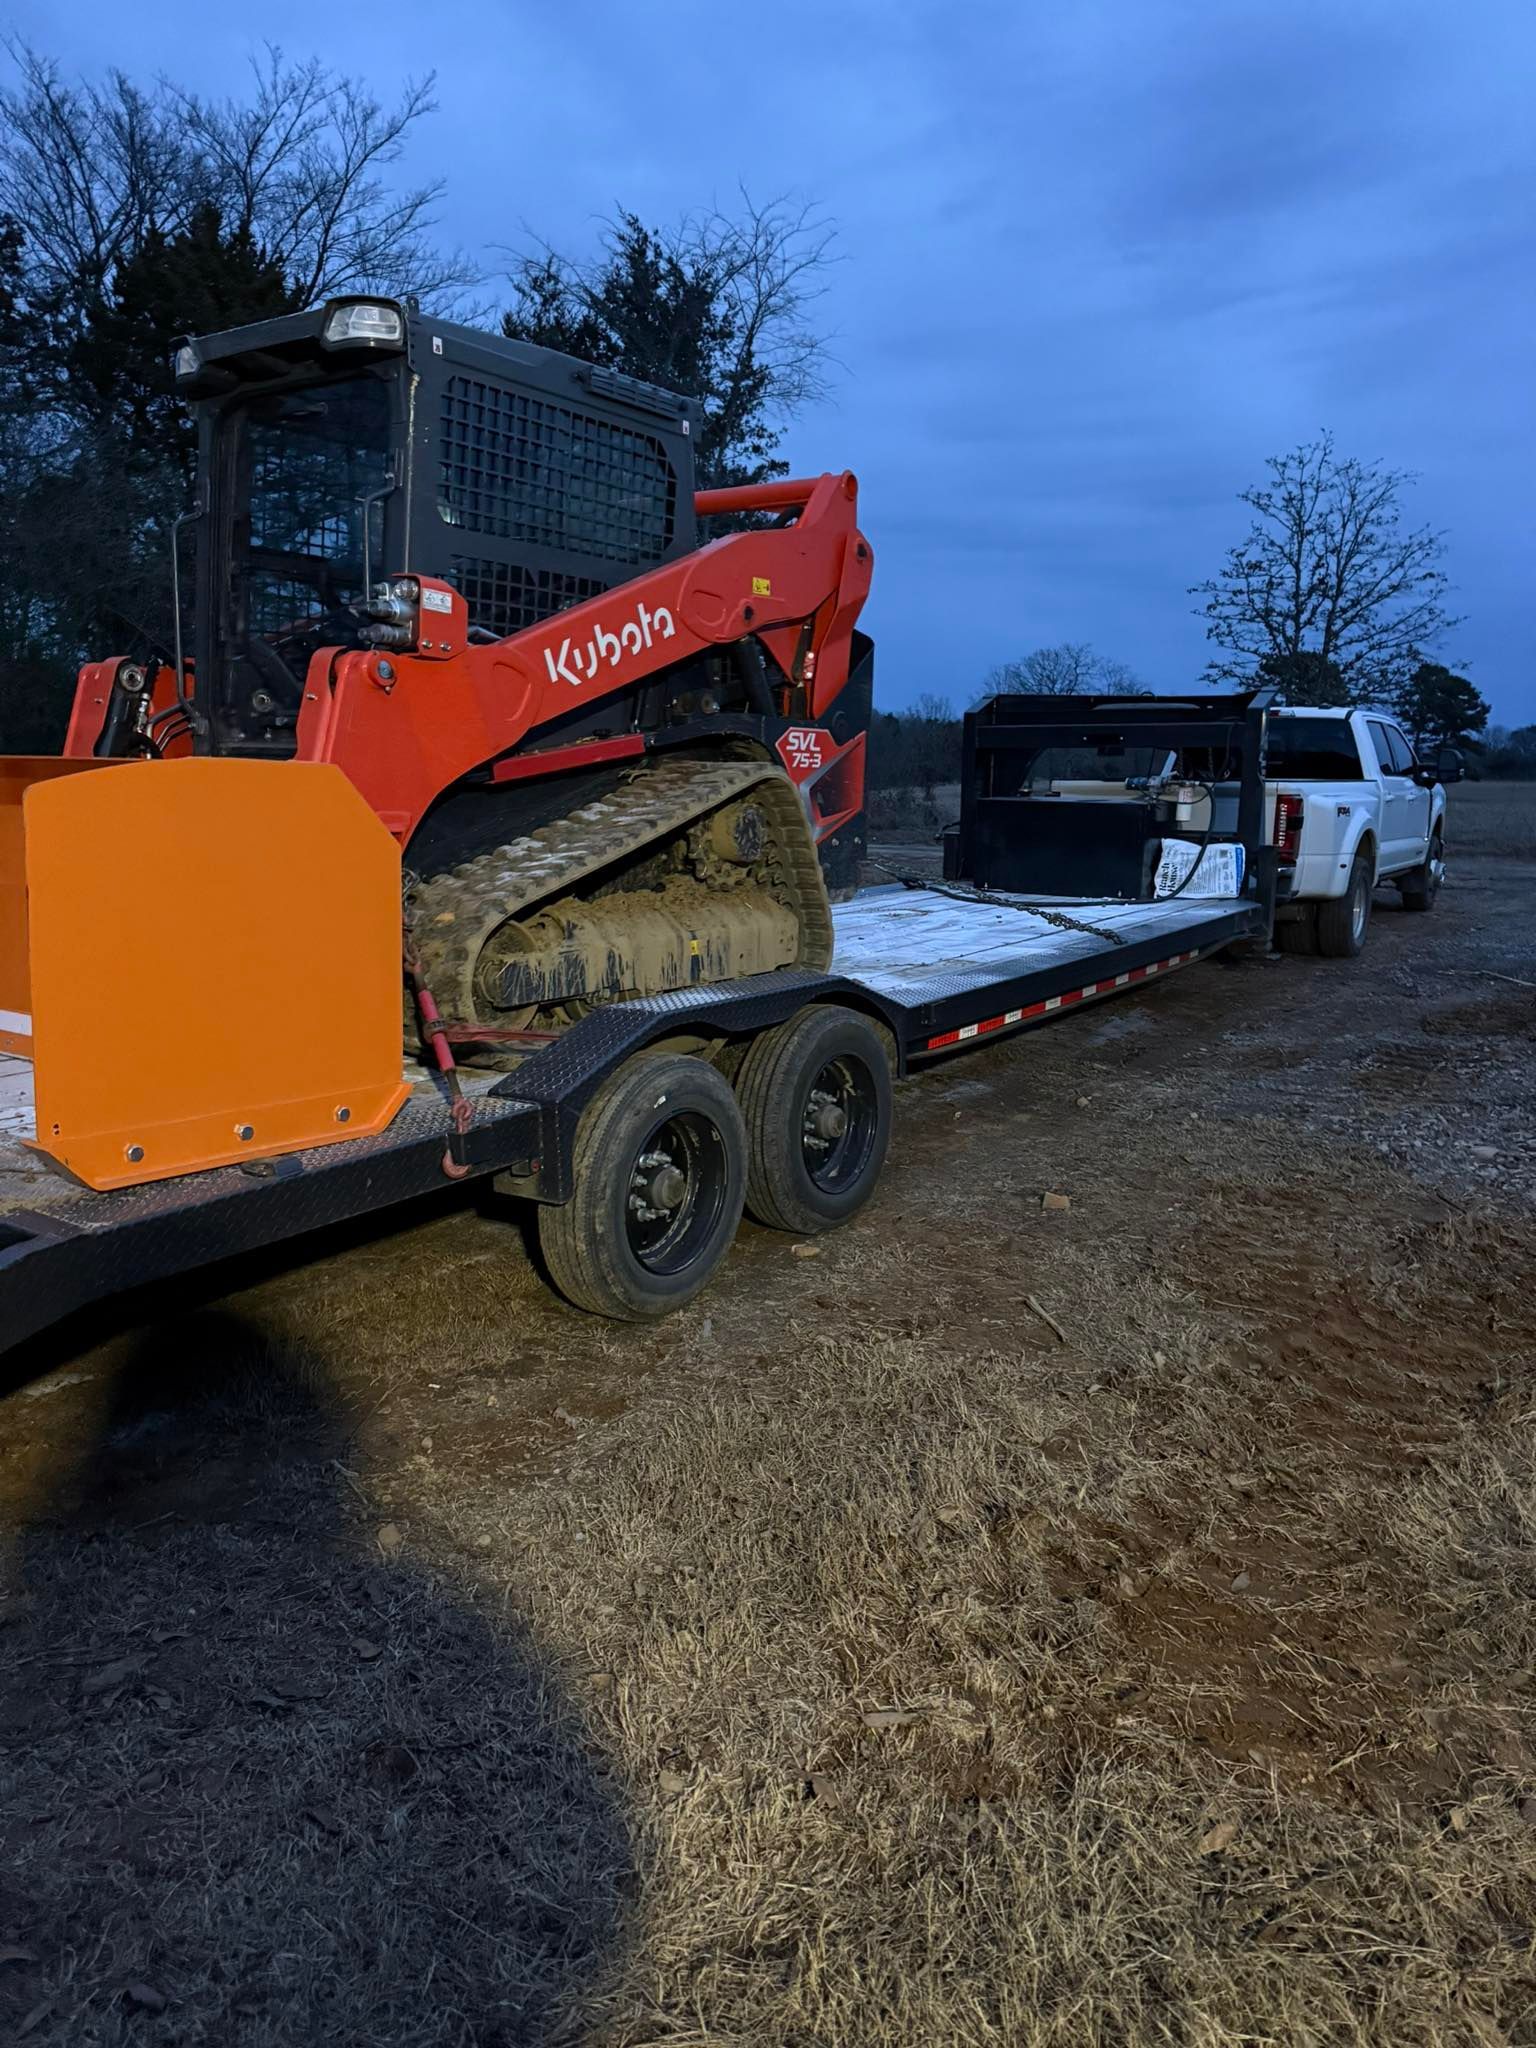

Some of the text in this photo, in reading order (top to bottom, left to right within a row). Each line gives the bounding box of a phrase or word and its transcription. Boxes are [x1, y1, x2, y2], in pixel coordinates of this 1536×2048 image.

[543, 602, 676, 686] Kubota
[786, 732, 821, 752] SVL
[791, 753, 822, 769] 75-3
[1158, 862, 1170, 892] Ranch
